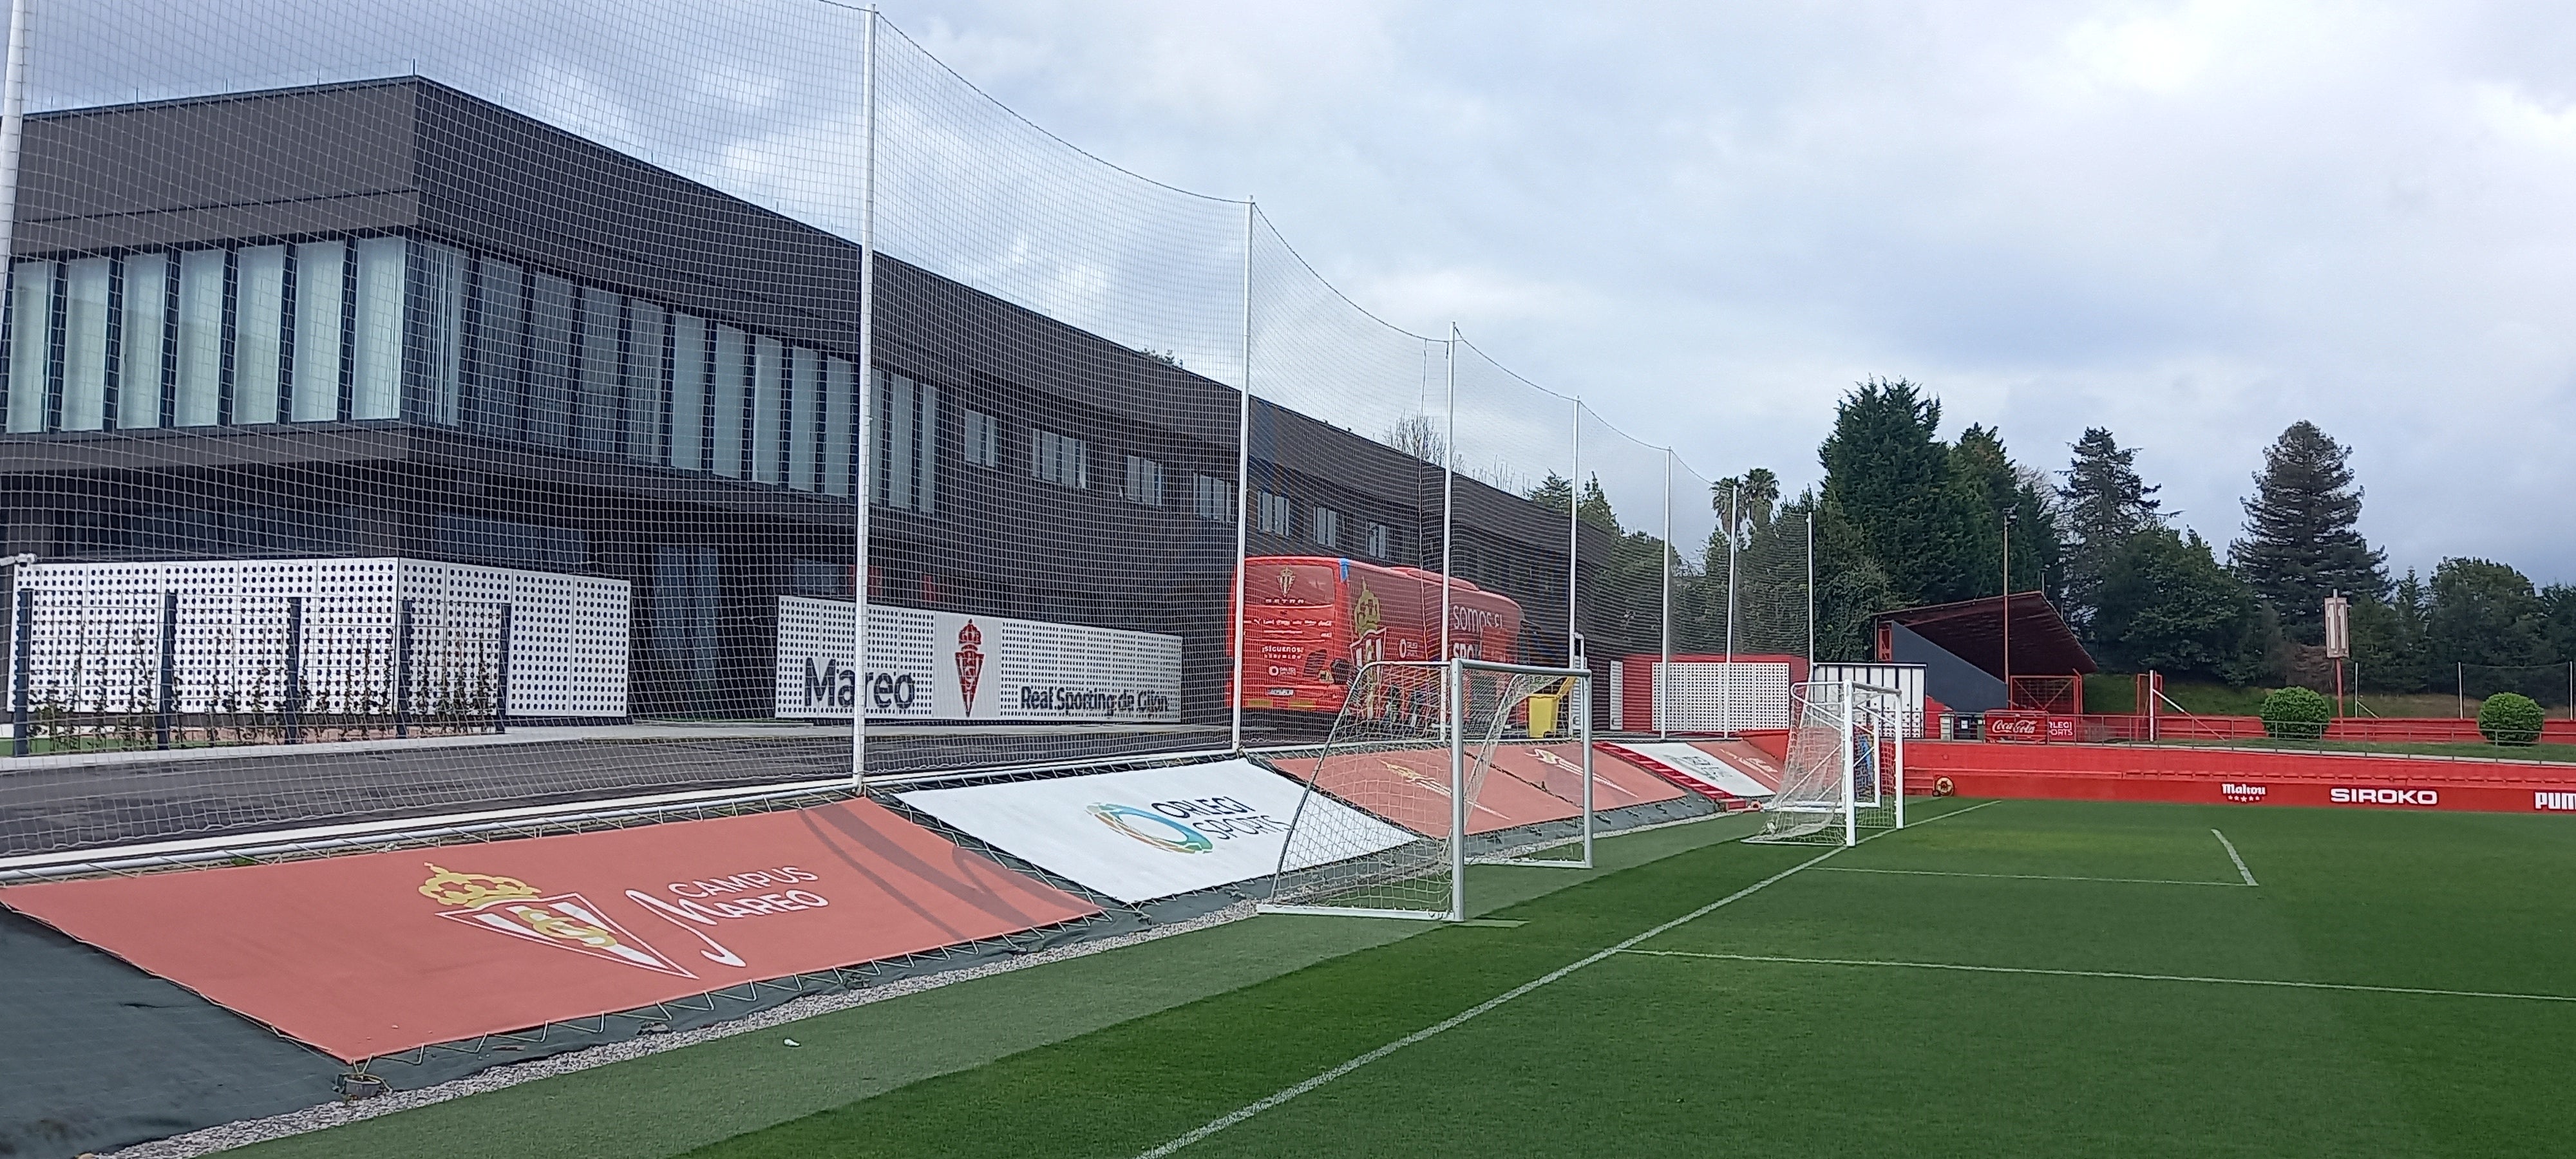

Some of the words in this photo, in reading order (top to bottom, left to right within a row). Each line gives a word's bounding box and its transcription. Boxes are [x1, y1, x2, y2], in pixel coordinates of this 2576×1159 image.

[804, 657, 915, 710] Mareo
[1021, 686, 1054, 710] Real
[1056, 686, 1114, 716] Sporting
[1118, 689, 1135, 709] de
[2222, 783, 2266, 796] Mahou
[2330, 787, 2438, 805] SIROKO
[1151, 796, 1256, 818] ORLEGI
[1192, 815, 1294, 840] SPORTS
[668, 866, 819, 898] CAMPUS
